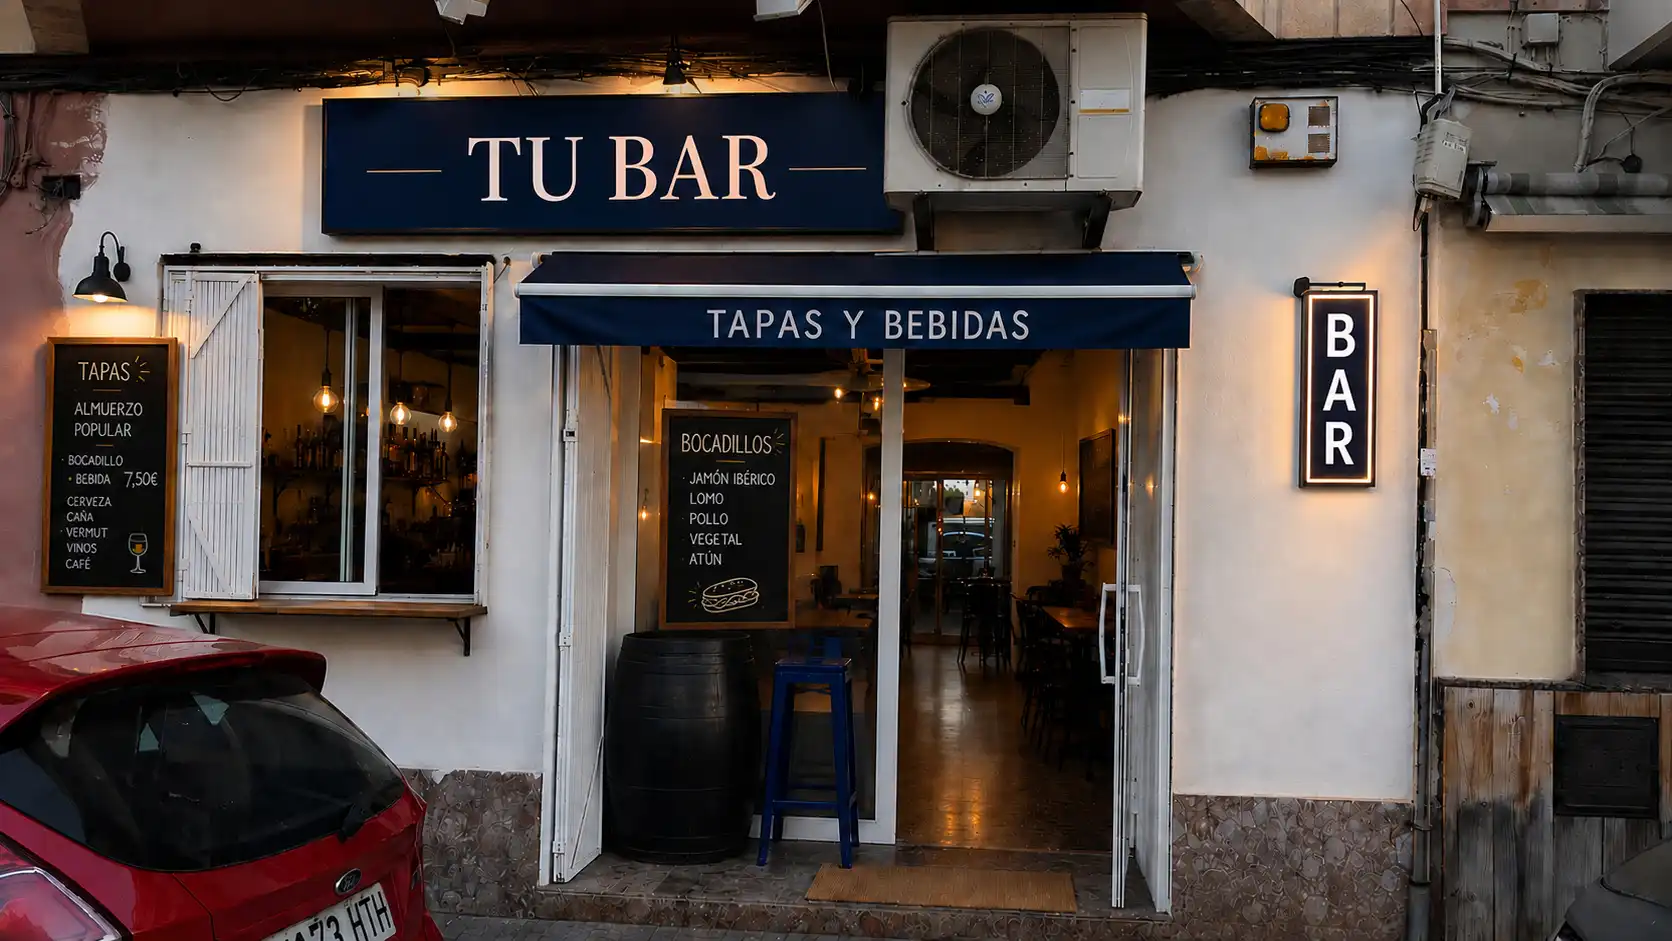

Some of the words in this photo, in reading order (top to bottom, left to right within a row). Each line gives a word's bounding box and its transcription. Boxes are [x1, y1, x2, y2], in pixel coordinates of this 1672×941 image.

[468, 136, 583, 202] TU
[608, 135, 776, 201] BAR
[706, 309, 822, 339] TAPAS
[843, 310, 864, 339] Y
[885, 310, 1029, 340] BEBIDAS
[77, 361, 131, 382] TAPAS
[1322, 313, 1357, 465] BAR
[74, 402, 143, 417] ALMUERZO
[74, 422, 132, 437] POPULAR
[681, 433, 772, 454] BOCADILLOS
[68, 454, 124, 467] BOCADILLO
[75, 473, 111, 485] BEBIDA
[123, 471, 158, 488] 7,50€
[689, 469, 729, 485] JAMÓN
[733, 470, 776, 486] IBÉRICO
[66, 496, 112, 507] CERVEZA
[689, 492, 724, 505] LOMO
[66, 510, 94, 522] CAÑA
[689, 512, 729, 525] POLLO
[66, 527, 109, 538] VERMUT
[689, 532, 743, 546] VEGETAL
[66, 542, 97, 554] VINOS
[65, 558, 91, 570] CAFÉ
[689, 550, 722, 566] ATÚN
[283, 914, 345, 941] 73
[346, 891, 392, 941] HTH
